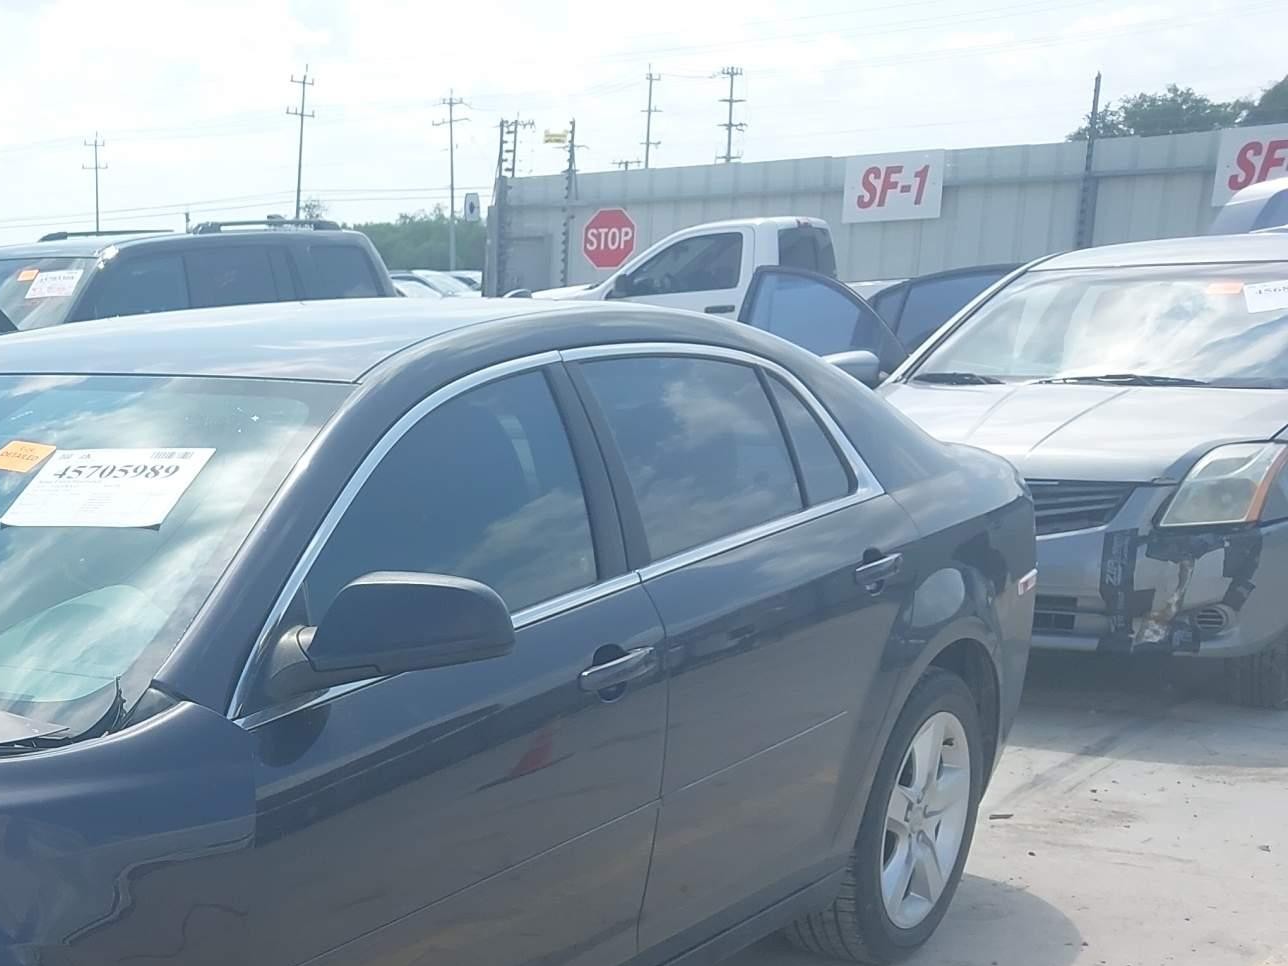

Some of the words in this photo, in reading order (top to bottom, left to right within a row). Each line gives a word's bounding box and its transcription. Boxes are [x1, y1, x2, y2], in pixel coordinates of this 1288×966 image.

[1228, 139, 1288, 191] SF
[856, 165, 930, 209] SF-1
[586, 227, 632, 250] STOP
[53, 464, 181, 480] 45705989
